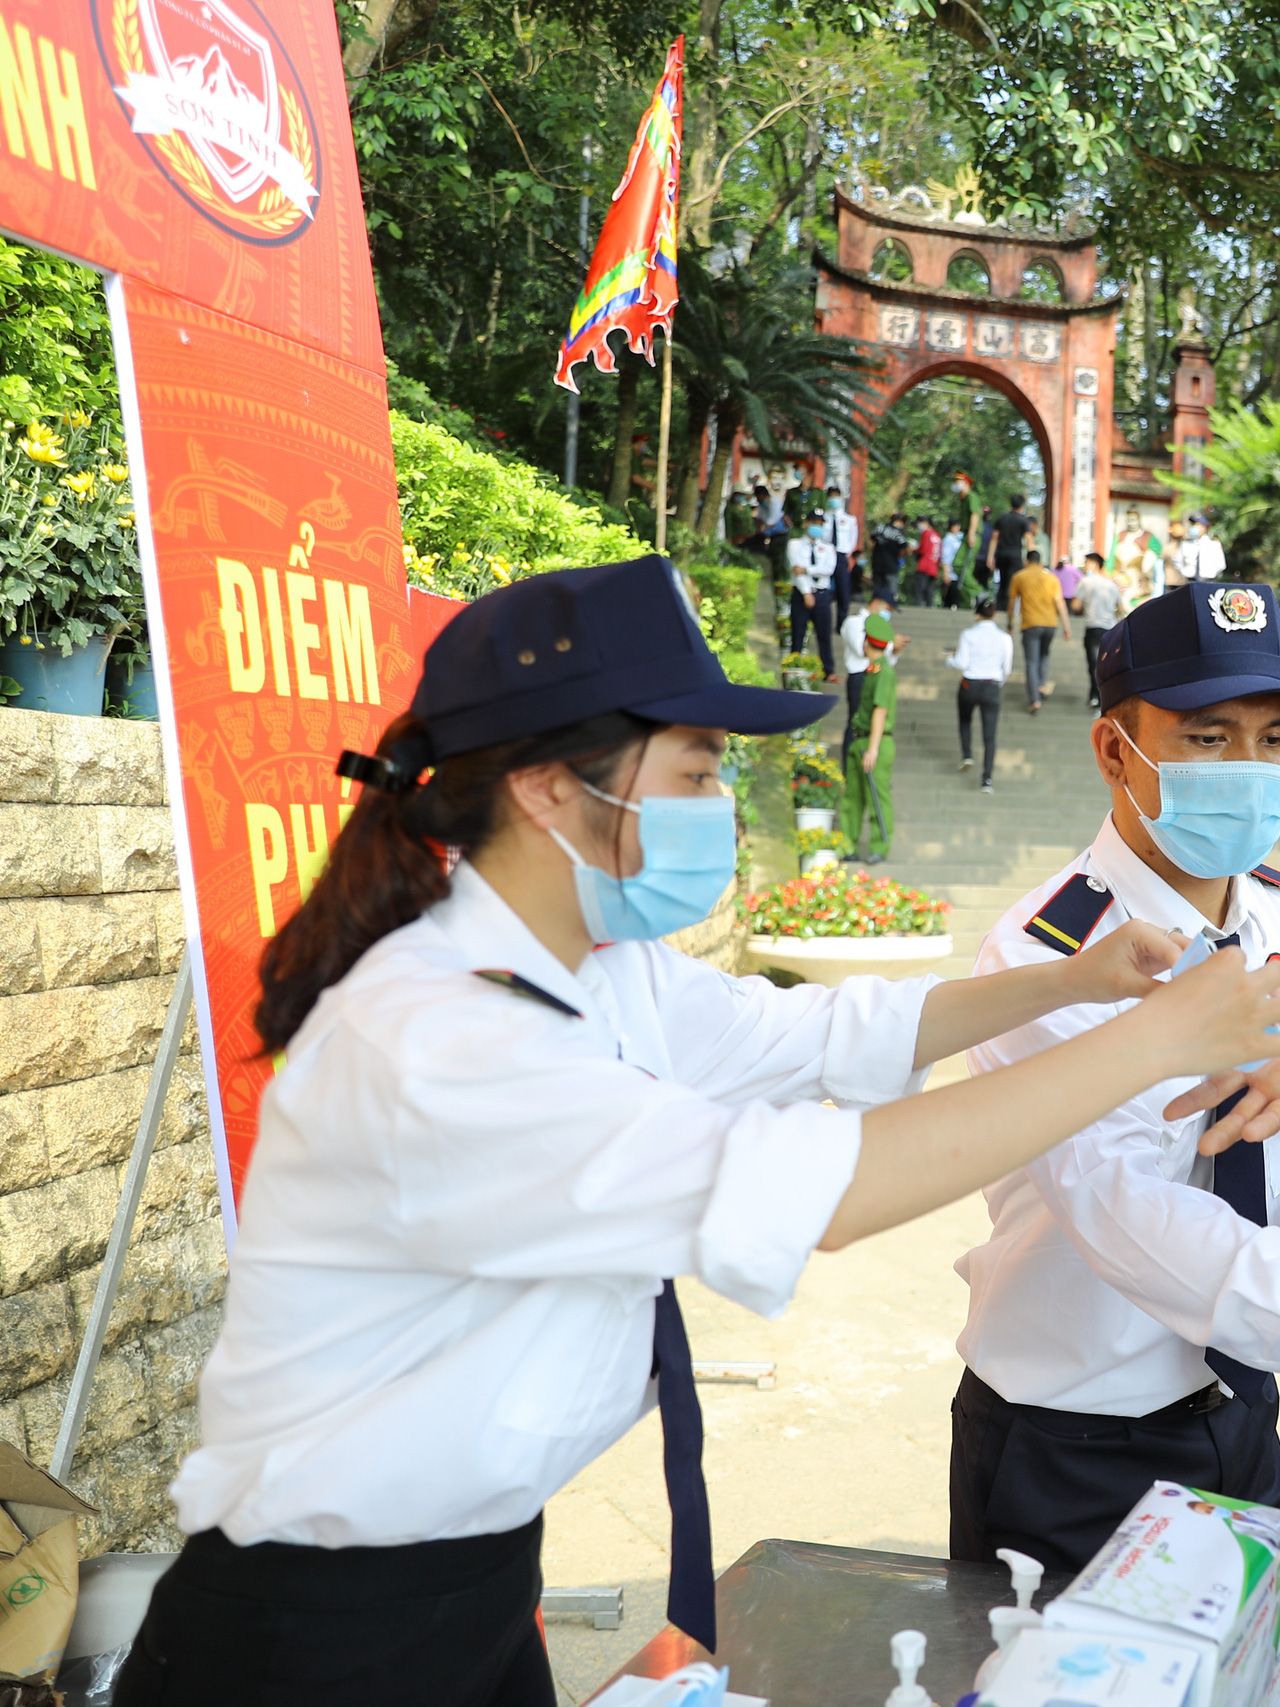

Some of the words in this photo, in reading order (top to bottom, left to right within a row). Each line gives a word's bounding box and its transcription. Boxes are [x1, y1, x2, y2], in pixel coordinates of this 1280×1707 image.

[165, 93, 215, 130] SƠN
[216, 522, 381, 706] ĐIỂM
[244, 774, 356, 938] PH
